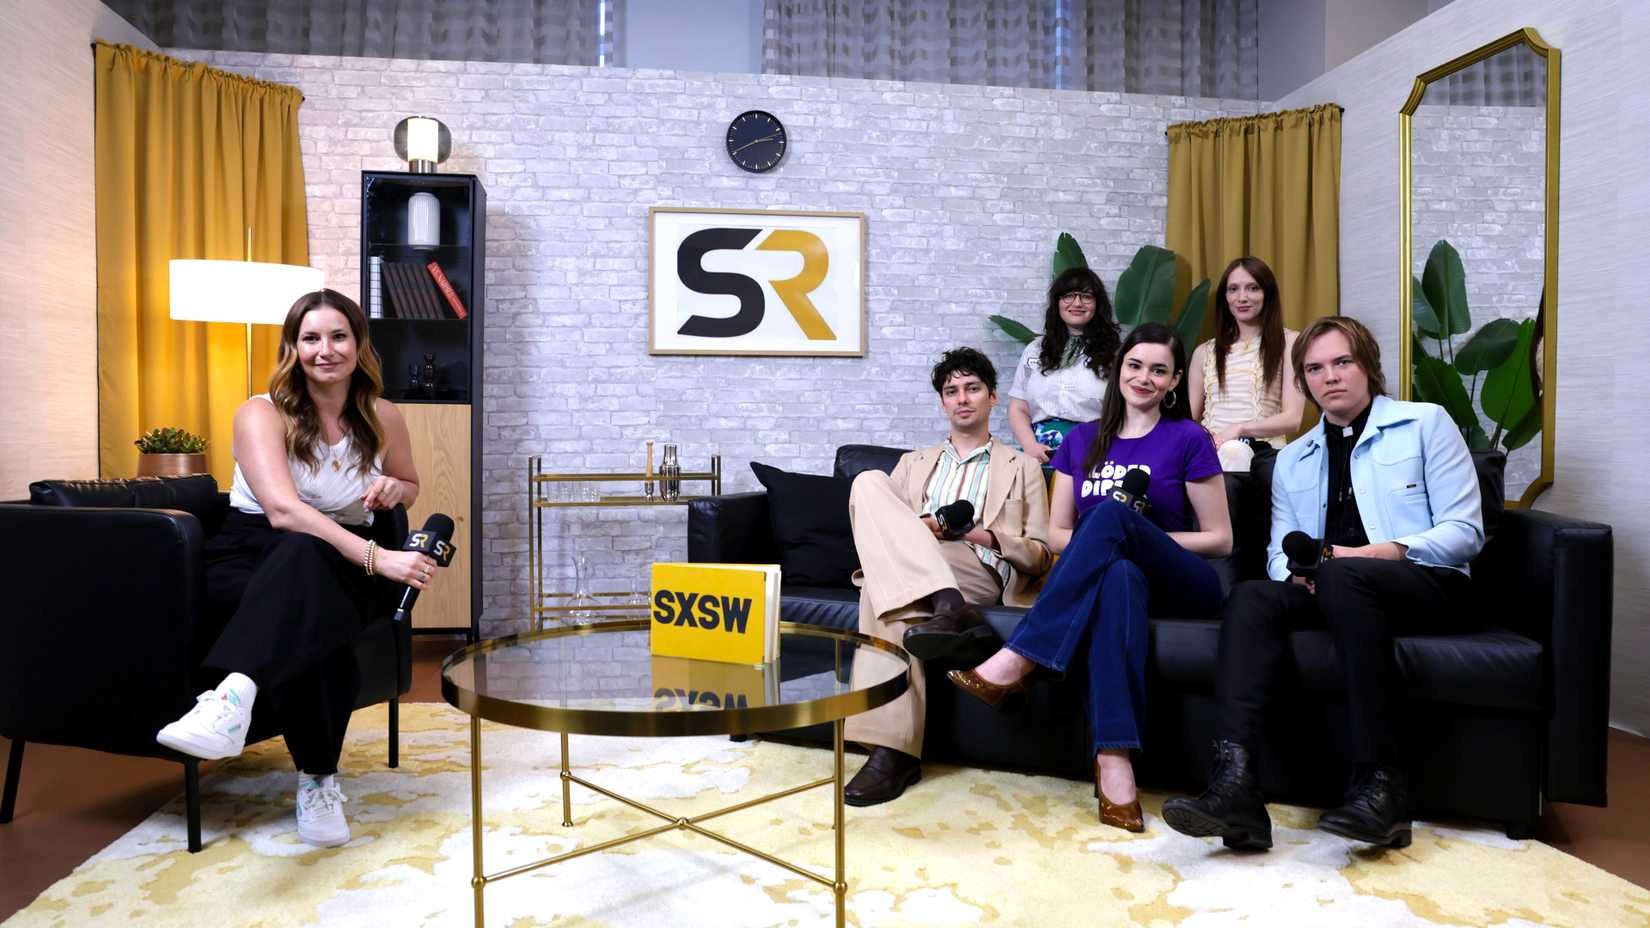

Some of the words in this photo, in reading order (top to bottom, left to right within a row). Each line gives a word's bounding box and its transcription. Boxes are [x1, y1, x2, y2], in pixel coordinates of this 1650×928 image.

[677, 228, 837, 341] SR
[409, 533, 429, 548] SR
[433, 540, 451, 561] SR
[653, 589, 752, 634] SXSW
